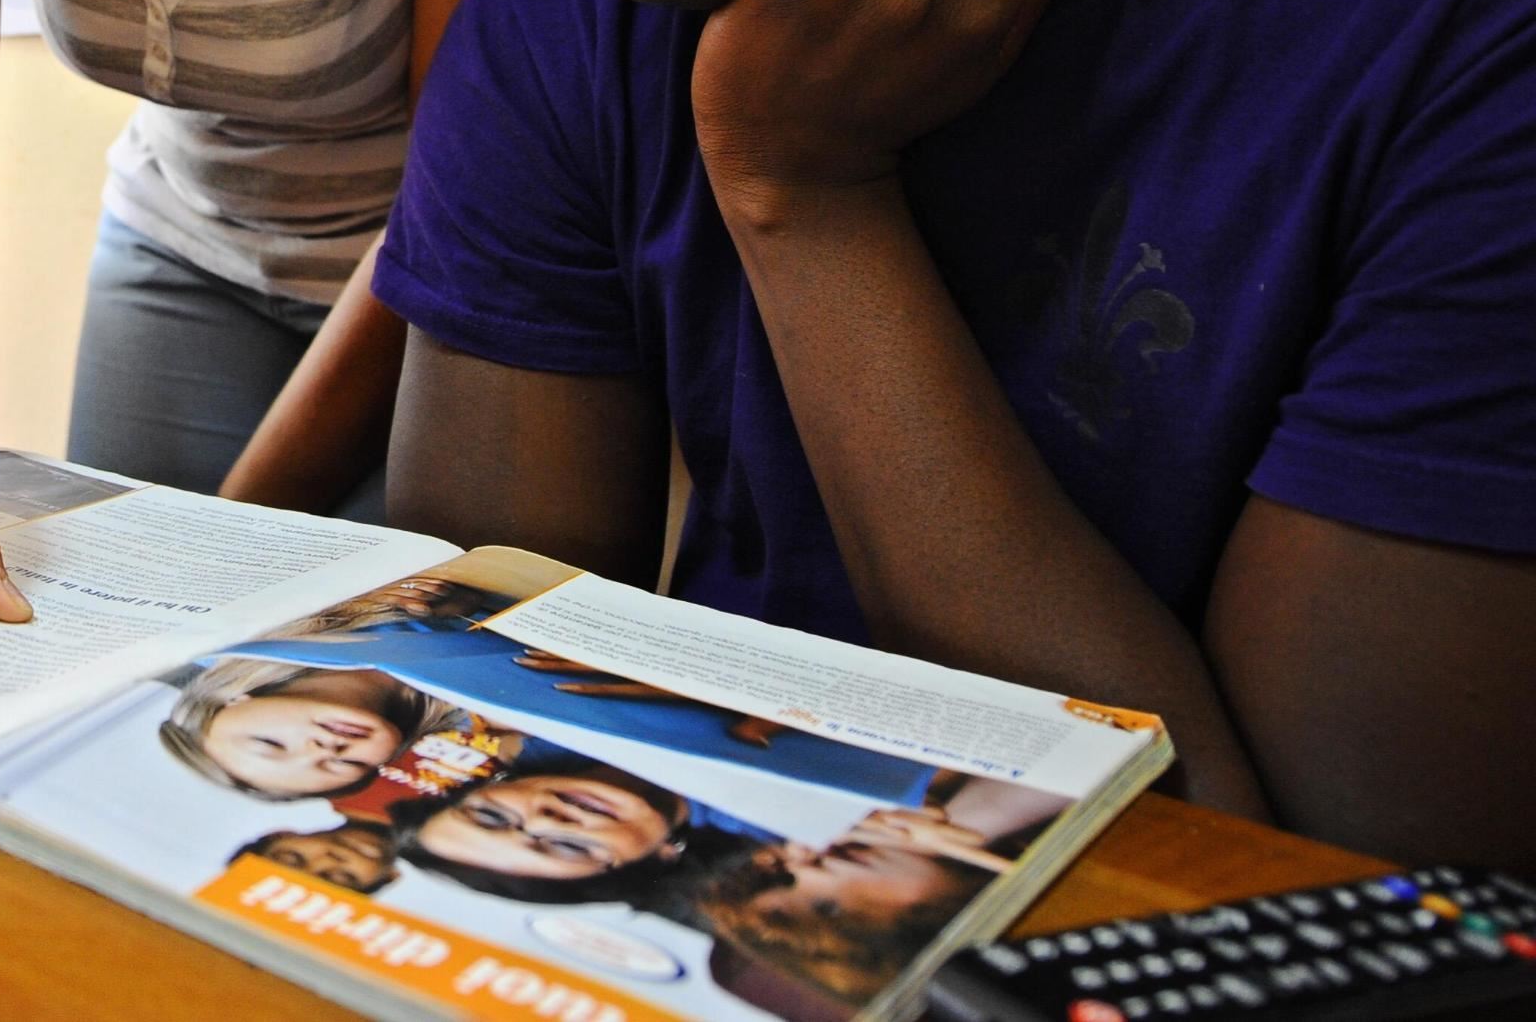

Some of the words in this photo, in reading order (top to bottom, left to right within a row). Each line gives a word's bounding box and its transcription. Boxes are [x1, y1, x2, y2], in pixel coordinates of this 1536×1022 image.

[6, 564, 60, 584] Italia?
[59, 580, 78, 593] in
[79, 586, 136, 604] potere
[133, 598, 153, 608] il
[156, 600, 179, 611] ha
[183, 603, 213, 616] Chi
[1009, 768, 1025, 781] A
[238, 876, 451, 968] diritti
